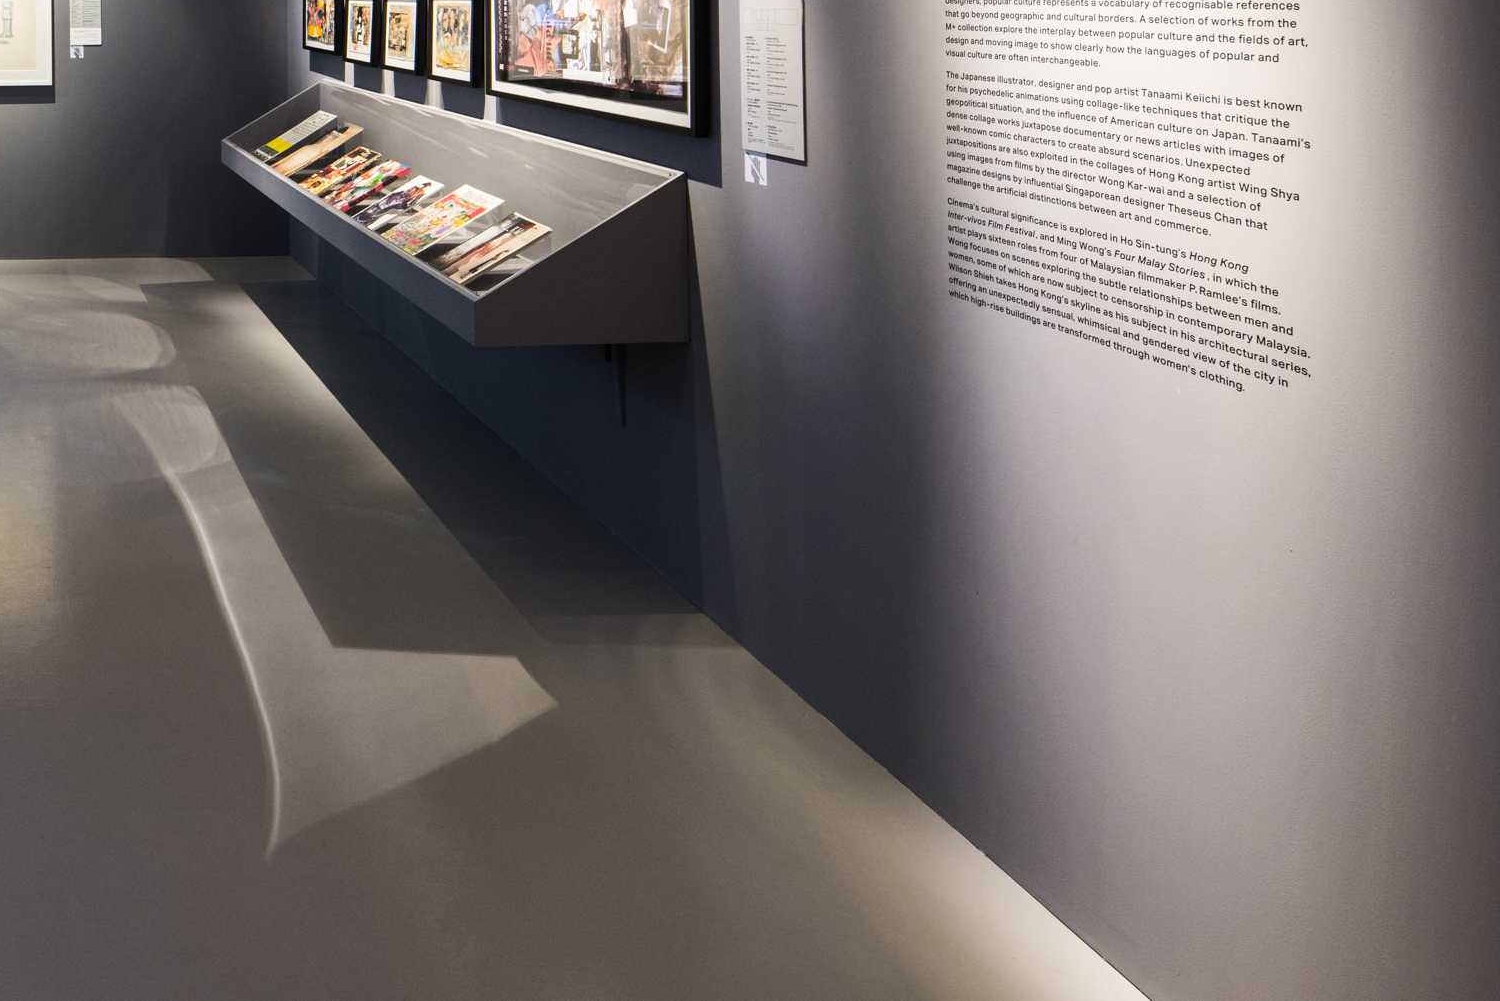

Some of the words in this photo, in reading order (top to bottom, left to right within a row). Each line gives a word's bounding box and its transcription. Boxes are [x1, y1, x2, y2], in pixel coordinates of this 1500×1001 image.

[945, 9, 959, 18] that
[960, 11, 970, 20] go
[971, 10, 999, 21] beyond
[1000, 11, 1044, 22] geographic
[1046, 12, 1061, 21] and
[1064, 12, 1096, 22] cultural
[1139, 14, 1146, 24] A
[1149, 14, 1195, 25] selection
[1198, 15, 1208, 25] of
[1211, 16, 1244, 27] works
[1247, 16, 1274, 28] from
[1278, 17, 1297, 28] the
[1165, 0, 1233, 11] recognisable
[1236, 0, 1300, 11] references
[945, 49, 966, 58] visual
[967, 50, 993, 60] culture
[994, 53, 1006, 61] are
[1008, 53, 1029, 62] often
[958, 23, 993, 33] collection
[994, 25, 1023, 35] explore
[1025, 26, 1038, 35] the
[1040, 26, 1076, 39] interplay
[1078, 28, 1116, 38] between
[1118, 30, 1154, 42] popular
[1157, 31, 1193, 42] culture
[1195, 32, 1215, 43] and
[1218, 33, 1235, 44] the
[1239, 34, 1270, 45] fields
[1273, 35, 1285, 46] of
[946, 70, 959, 79] The
[960, 71, 995, 83] Japanese
[1038, 78, 1074, 91] designer
[1076, 82, 1093, 92] and
[1095, 85, 1112, 96] pop
[1114, 86, 1139, 96] artist
[1141, 87, 1182, 101] Tanaami
[1186, 91, 1220, 104] Keiichi
[1223, 95, 1233, 105] is
[1236, 96, 1260, 108] best
[1264, 98, 1302, 112] known
[946, 83, 956, 92] for
[958, 84, 968, 94] his
[969, 87, 1014, 99] psychedelic
[1015, 91, 1059, 104] animations
[1061, 96, 1084, 109] using
[1086, 99, 1140, 112] collage-like
[1142, 103, 1198, 119] techniques
[1201, 109, 1221, 121] that
[1225, 113, 1268, 127] critique
[1271, 116, 1290, 129] the
[946, 109, 968, 120] dense
[969, 113, 996, 125] collage
[997, 118, 1020, 127] works
[1022, 119, 1061, 133] juxtapose
[1063, 124, 1121, 143] documentary
[1123, 134, 1133, 143] or
[1136, 136, 1160, 146] news
[1163, 139, 1201, 152] articles
[1204, 144, 1226, 155] with
[1229, 146, 1270, 162] images
[1273, 152, 1284, 163] of
[946, 135, 997, 152] juxtapositions
[998, 146, 1011, 154] are
[1012, 147, 1029, 157] also
[1030, 151, 1068, 163] exploited
[1070, 155, 1078, 165] in
[1080, 156, 1094, 168] the
[1096, 161, 1134, 175] collages
[1137, 166, 1146, 176] of
[1149, 167, 1175, 183] Hong
[1178, 172, 1204, 188] Kong
[1207, 178, 1235, 191] artist
[1239, 181, 1267, 199] Wing
[1270, 186, 1300, 203] Shya
[947, 163, 980, 176] magazine
[982, 168, 1011, 182] designs
[1013, 174, 1023, 186] by
[1024, 176, 1063, 192] influential
[1065, 183, 1121, 203] Singaporean
[1123, 194, 1165, 211] designer
[1168, 202, 1212, 220] Theseus
[1214, 211, 1242, 226] Chan
[1245, 217, 1268, 231] that
[948, 235, 968, 251] Wong
[969, 241, 999, 257] focuses
[1000, 251, 1010, 260] on
[1012, 254, 1040, 268] scenes
[1041, 262, 1080, 281] exploring
[1082, 271, 1097, 283] the
[1098, 277, 1127, 291] subtle
[1129, 285, 1193, 310] relationships
[1195, 300, 1241, 322] between
[1244, 315, 1269, 330] men
[1271, 323, 1293, 336] and
